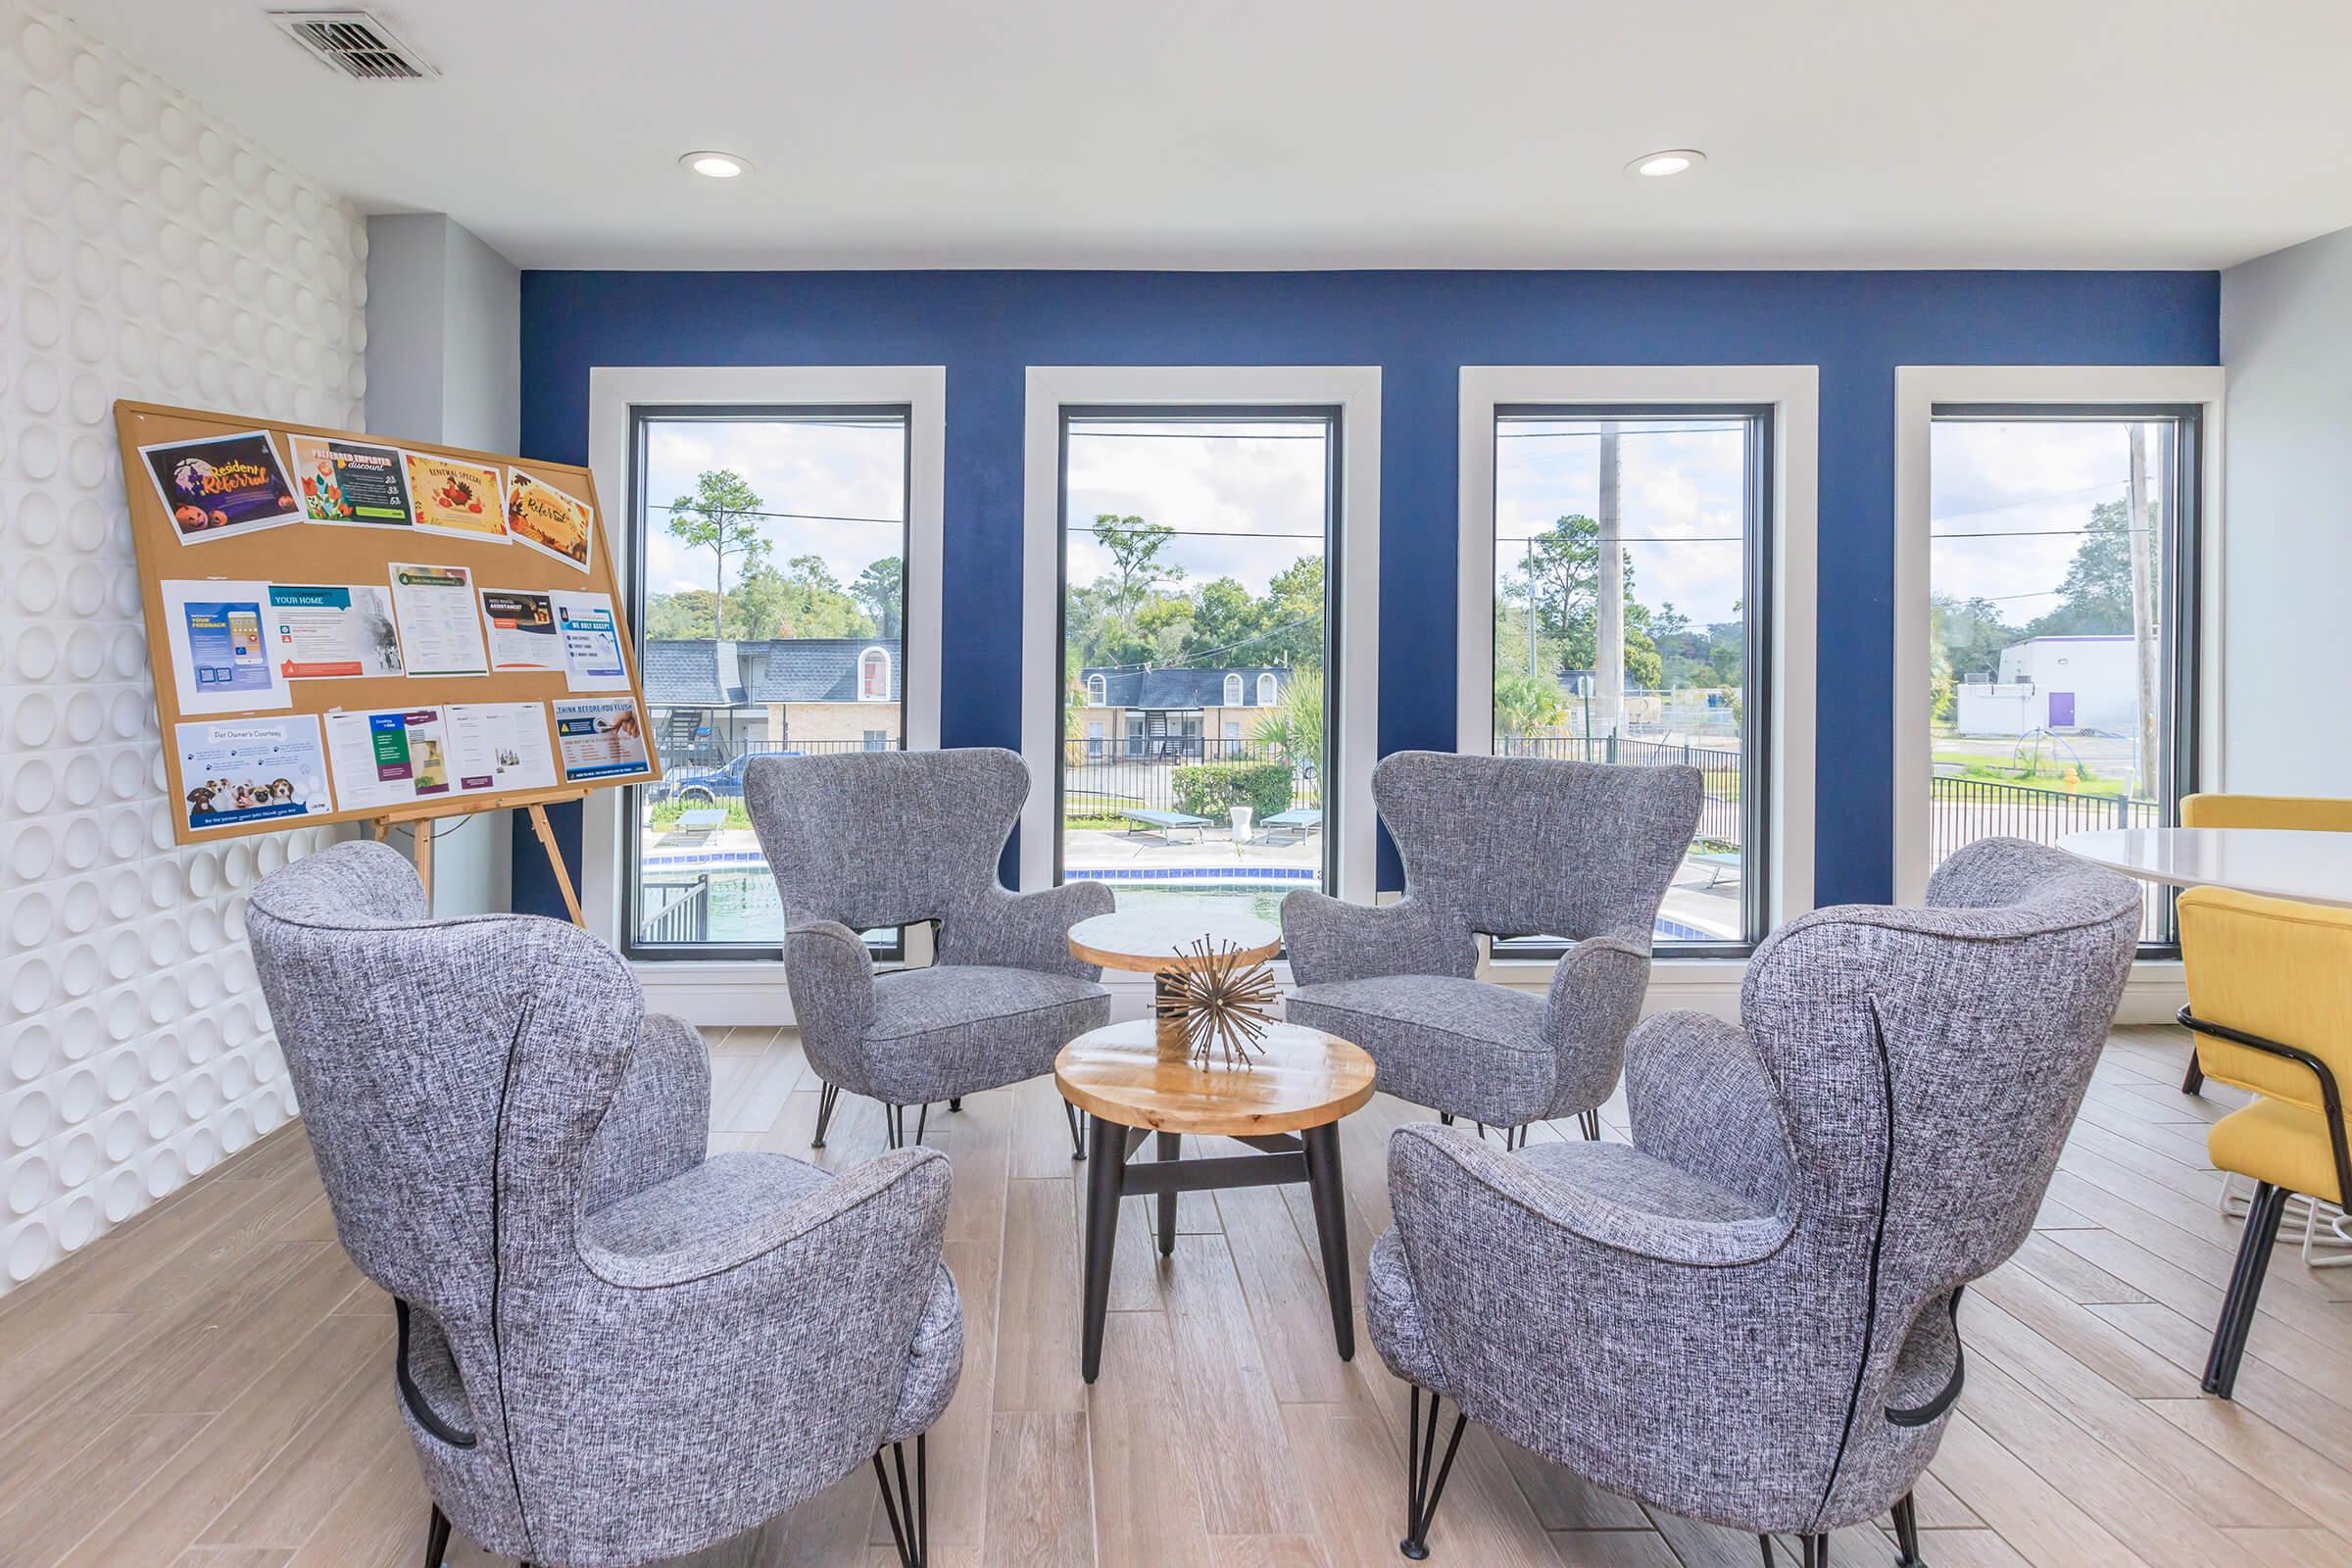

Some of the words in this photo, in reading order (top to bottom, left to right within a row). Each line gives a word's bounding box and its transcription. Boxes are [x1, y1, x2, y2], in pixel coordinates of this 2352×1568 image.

[211, 460, 260, 477] Resident
[348, 461, 384, 471] discount
[203, 466, 269, 493] Referral
[459, 471, 482, 485] SPECIAL
[528, 498, 566, 523] Referral
[274, 596, 299, 605] YOUR
[557, 706, 577, 714] THINK
[577, 705, 601, 713] BEFORE
[253, 729, 282, 738] Courtesy
